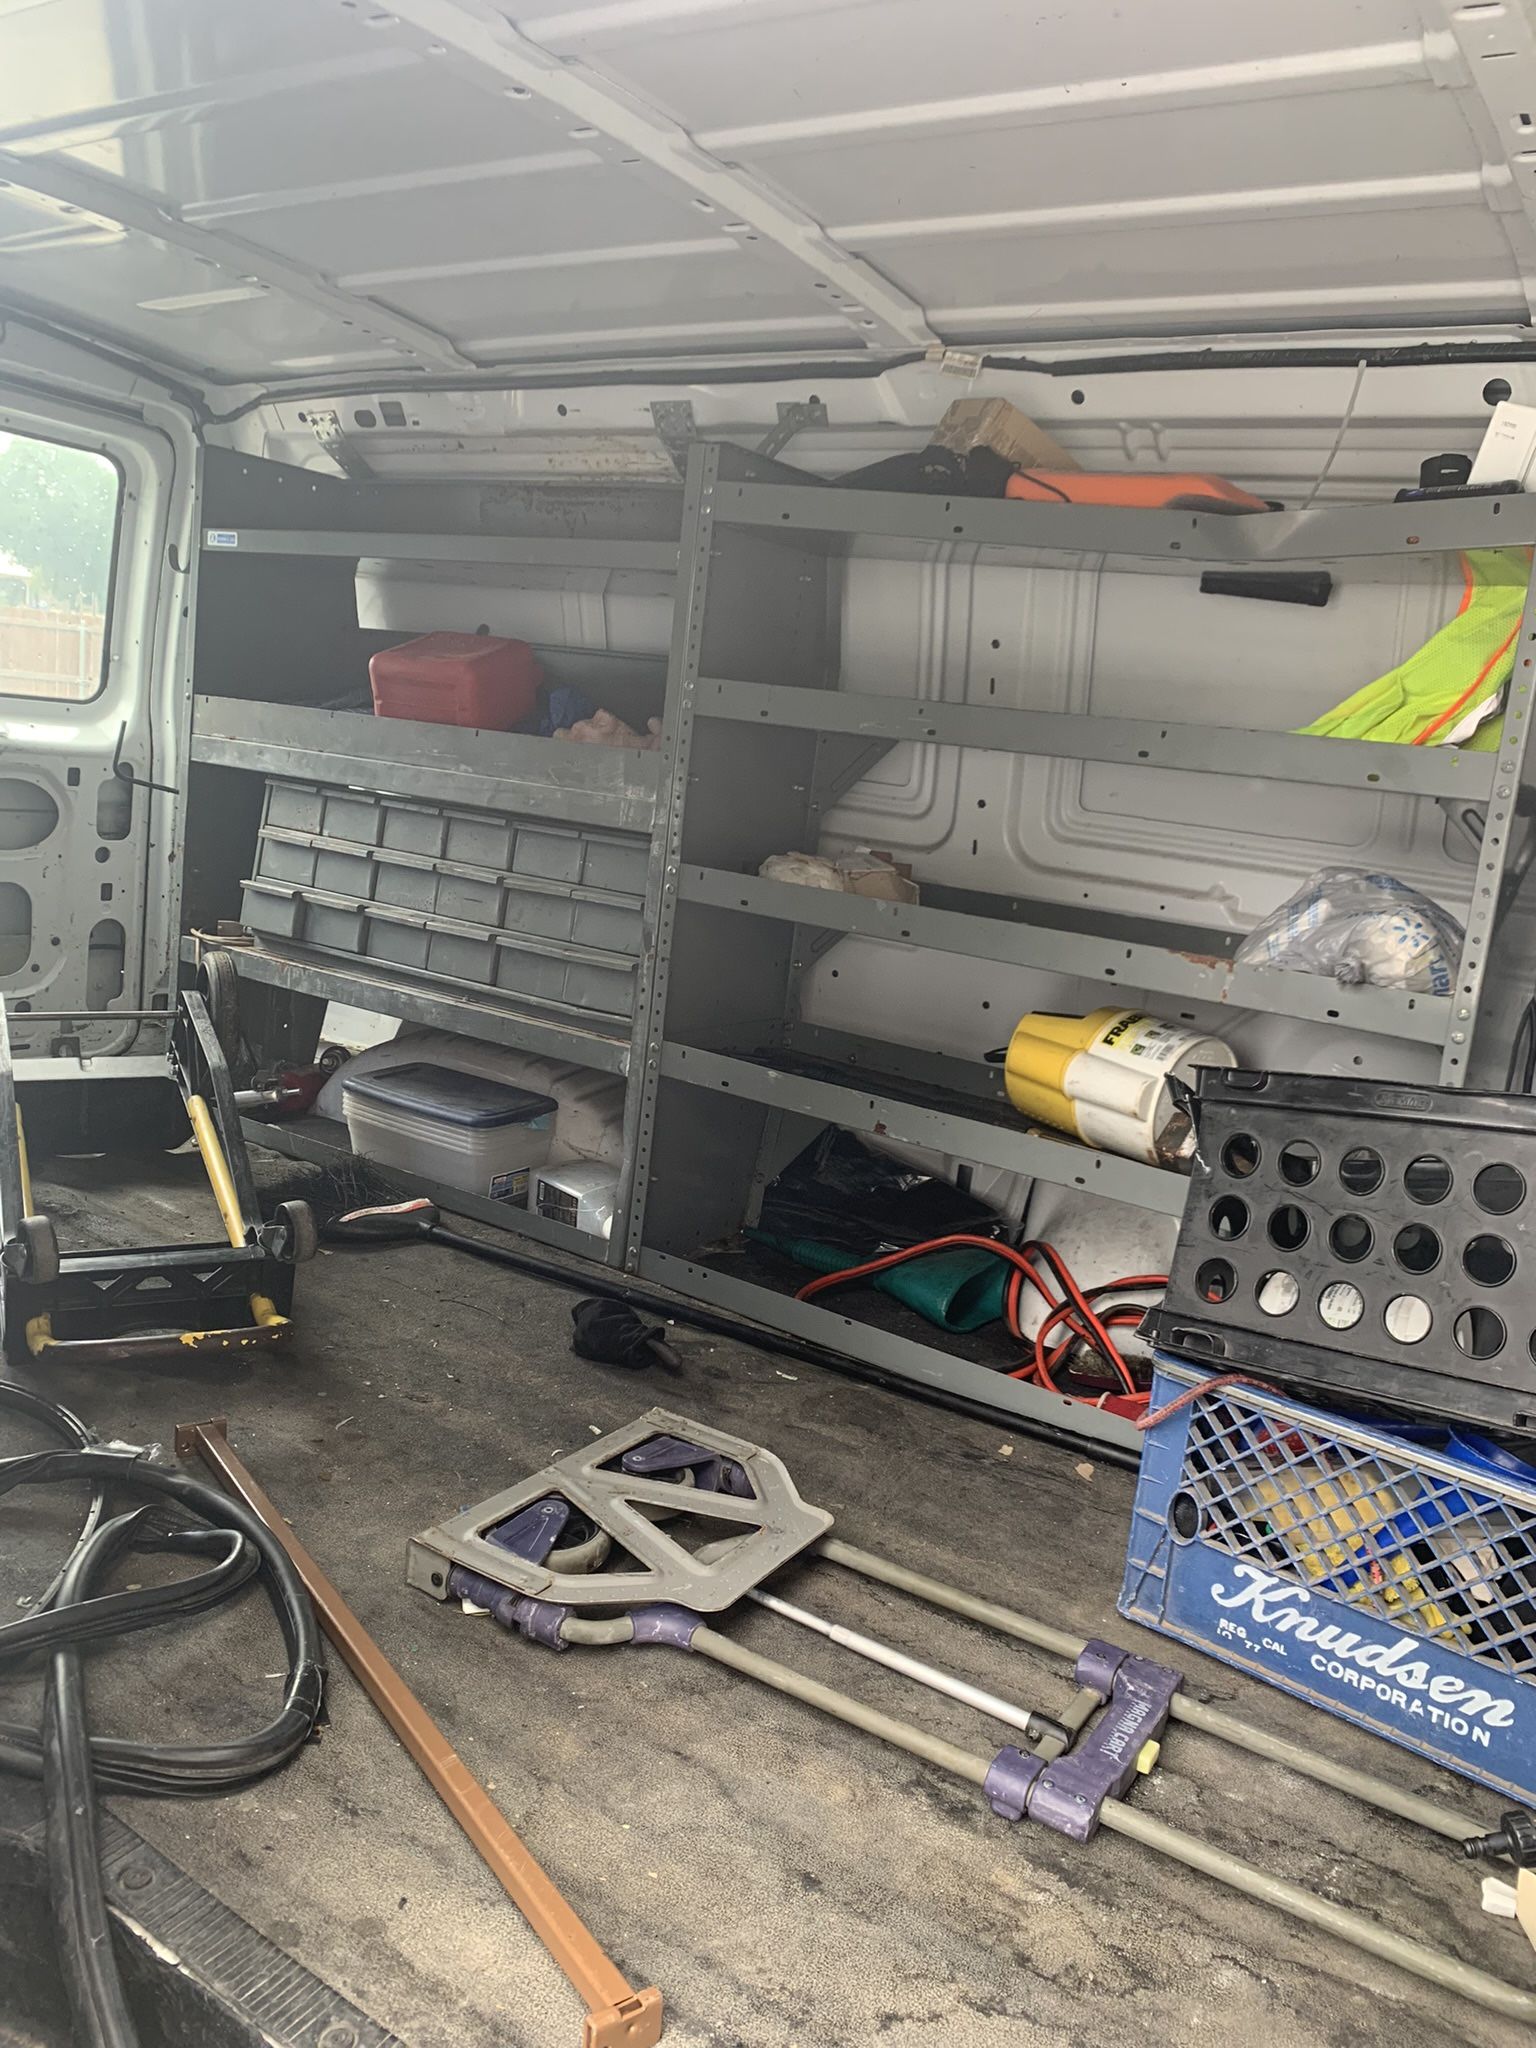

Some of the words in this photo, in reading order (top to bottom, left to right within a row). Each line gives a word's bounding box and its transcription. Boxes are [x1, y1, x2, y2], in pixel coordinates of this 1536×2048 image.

[1211, 1563, 1515, 1727] Knudsen
[1218, 1617, 1247, 1639] REG
[1262, 1637, 1288, 1656] CAL
[1115, 1697, 1152, 1735] MAGNA
[1310, 1654, 1491, 1748] CORPORATION
[1099, 1728, 1130, 1760] CART
